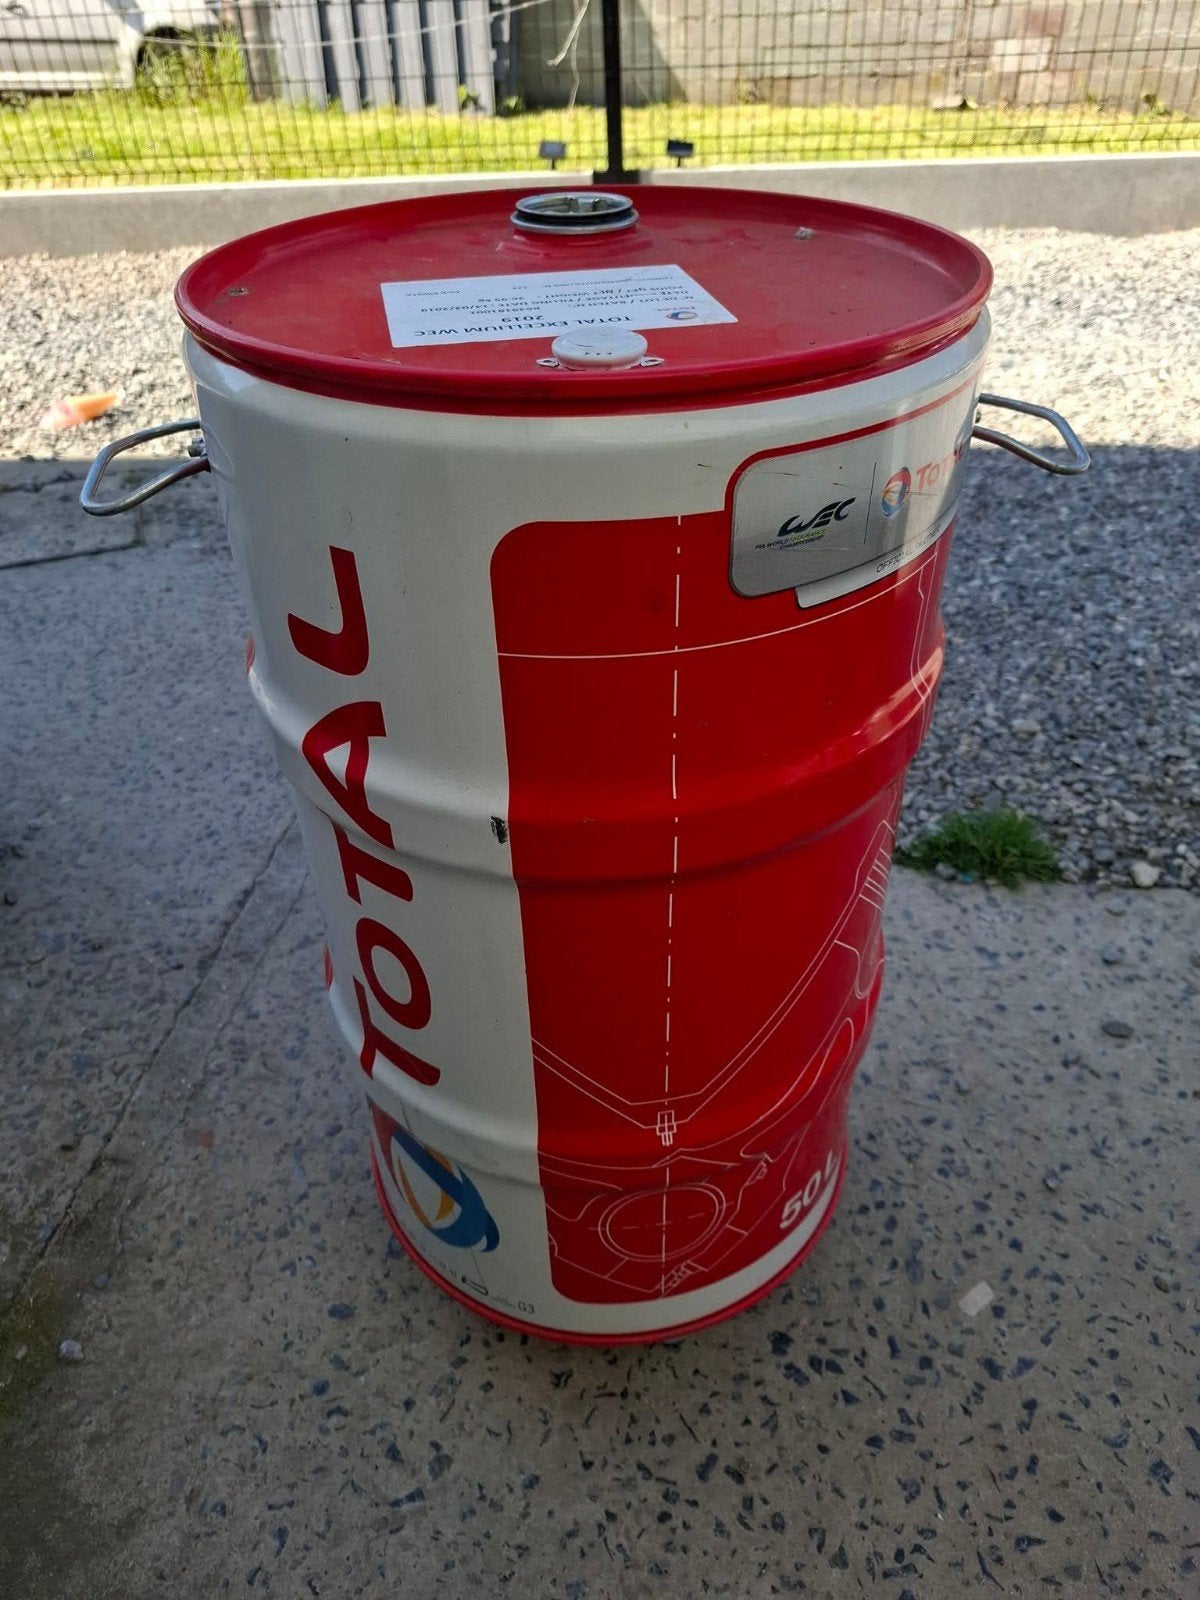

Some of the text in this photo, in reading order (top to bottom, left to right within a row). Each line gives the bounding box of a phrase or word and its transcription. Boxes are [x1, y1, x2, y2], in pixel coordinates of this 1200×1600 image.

[413, 315, 635, 337] TOTAL EXCELLIUM WEC
[501, 315, 544, 323] 2019
[777, 497, 856, 537] WEC
[288, 545, 441, 1086] TOTAL
[779, 1170, 821, 1229] 50
